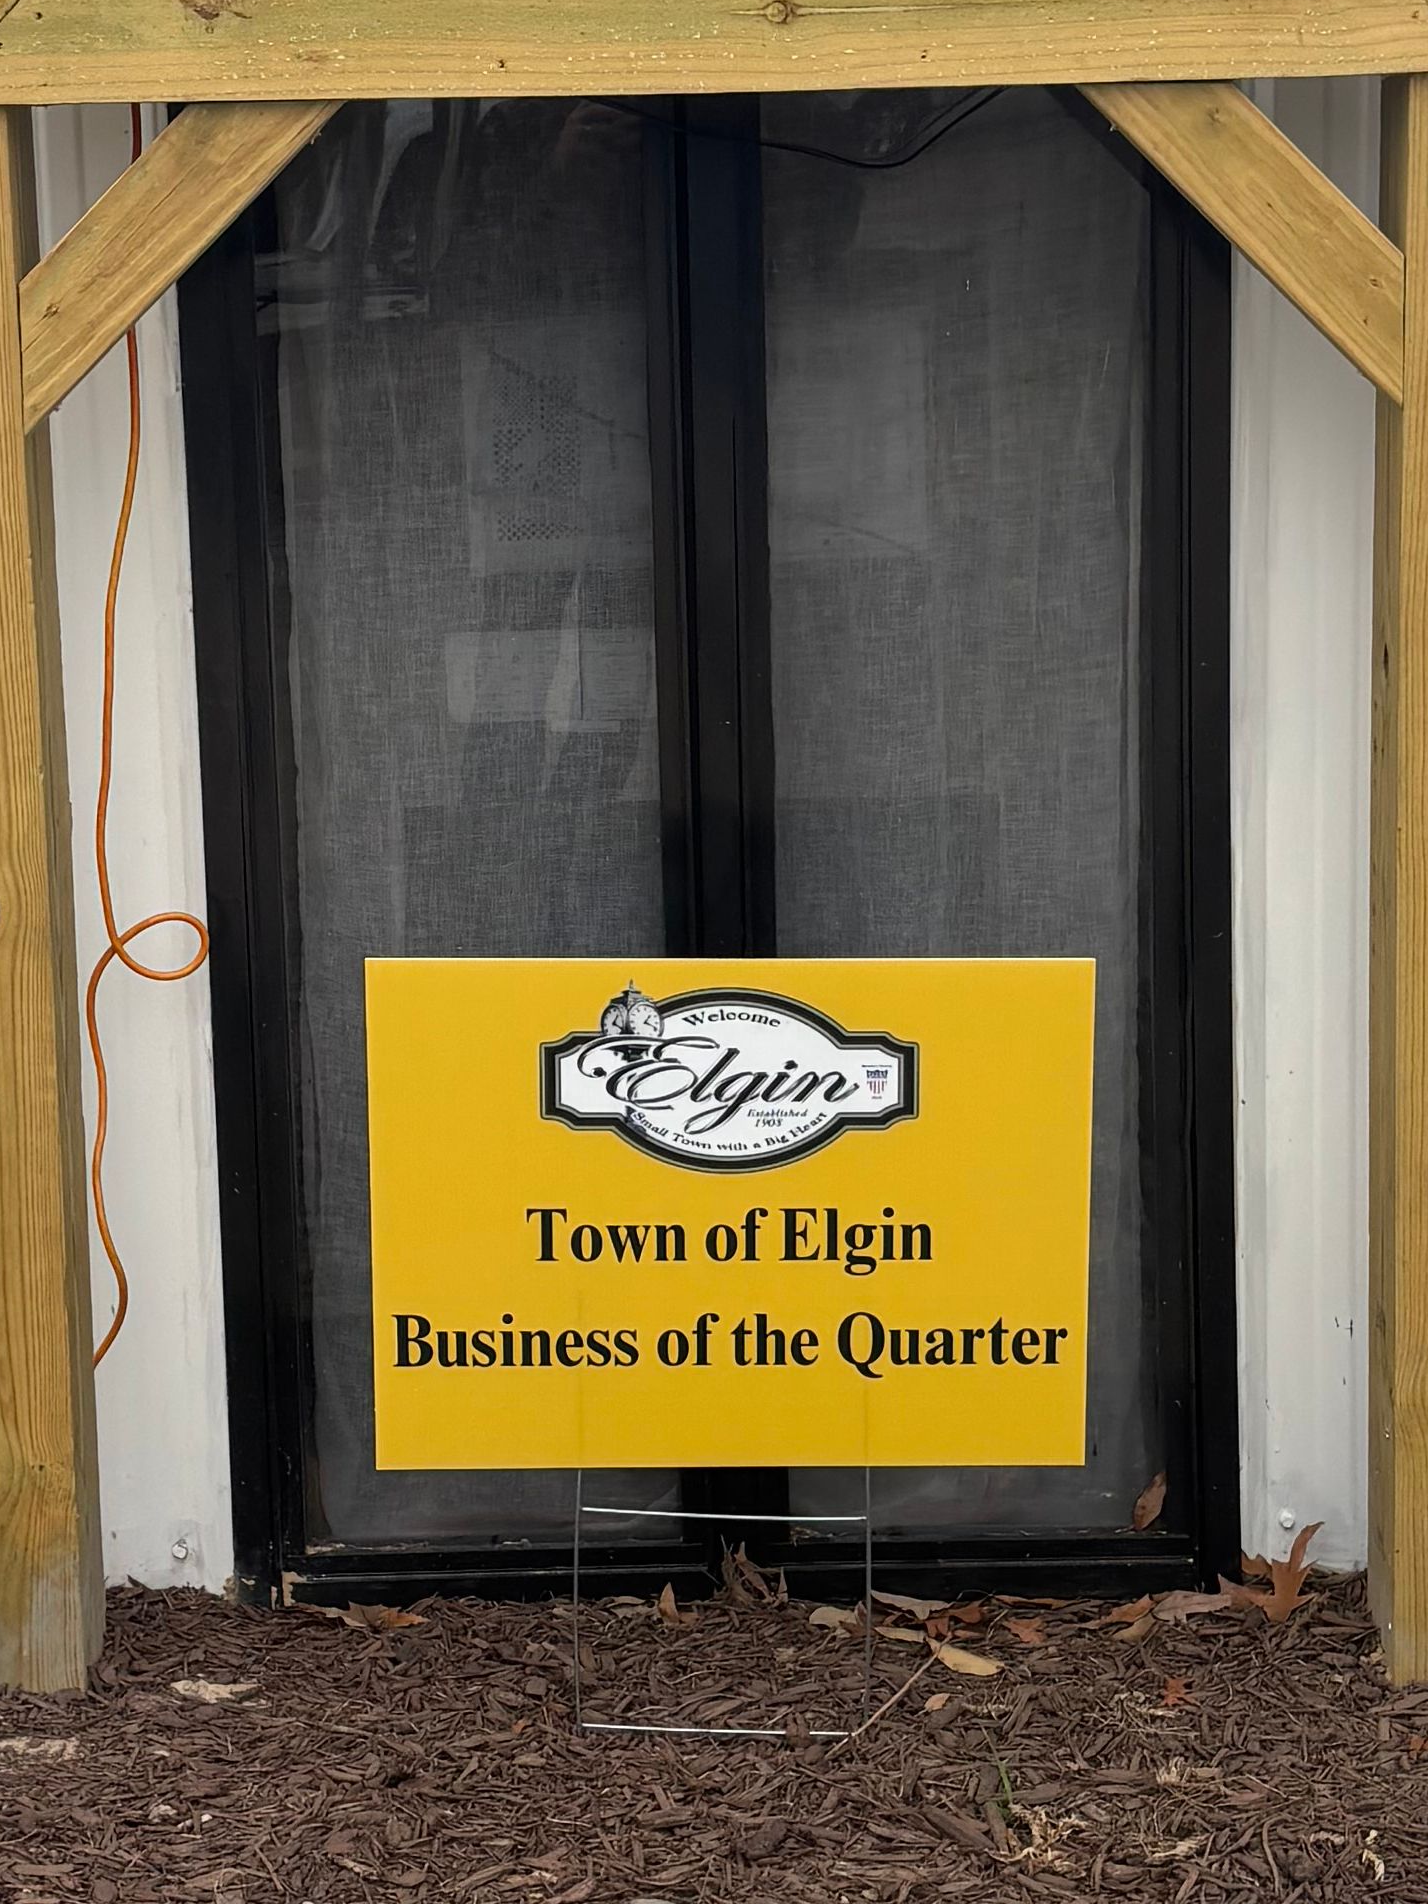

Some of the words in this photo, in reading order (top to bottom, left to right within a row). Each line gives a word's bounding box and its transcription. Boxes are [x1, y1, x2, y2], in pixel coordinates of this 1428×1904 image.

[682, 1009, 781, 1028] Welcome
[577, 1035, 860, 1135] Elgin
[631, 1110, 669, 1137] Small
[672, 1132, 711, 1150] Town
[717, 1143, 747, 1151] with
[765, 1136, 789, 1146] Big
[526, 1207, 687, 1263] Town
[704, 1207, 769, 1263] of
[778, 1207, 933, 1277] Elgin
[391, 1313, 638, 1368] Business
[656, 1312, 719, 1367] of
[731, 1313, 819, 1367] the
[837, 1311, 1068, 1379] Quarter
